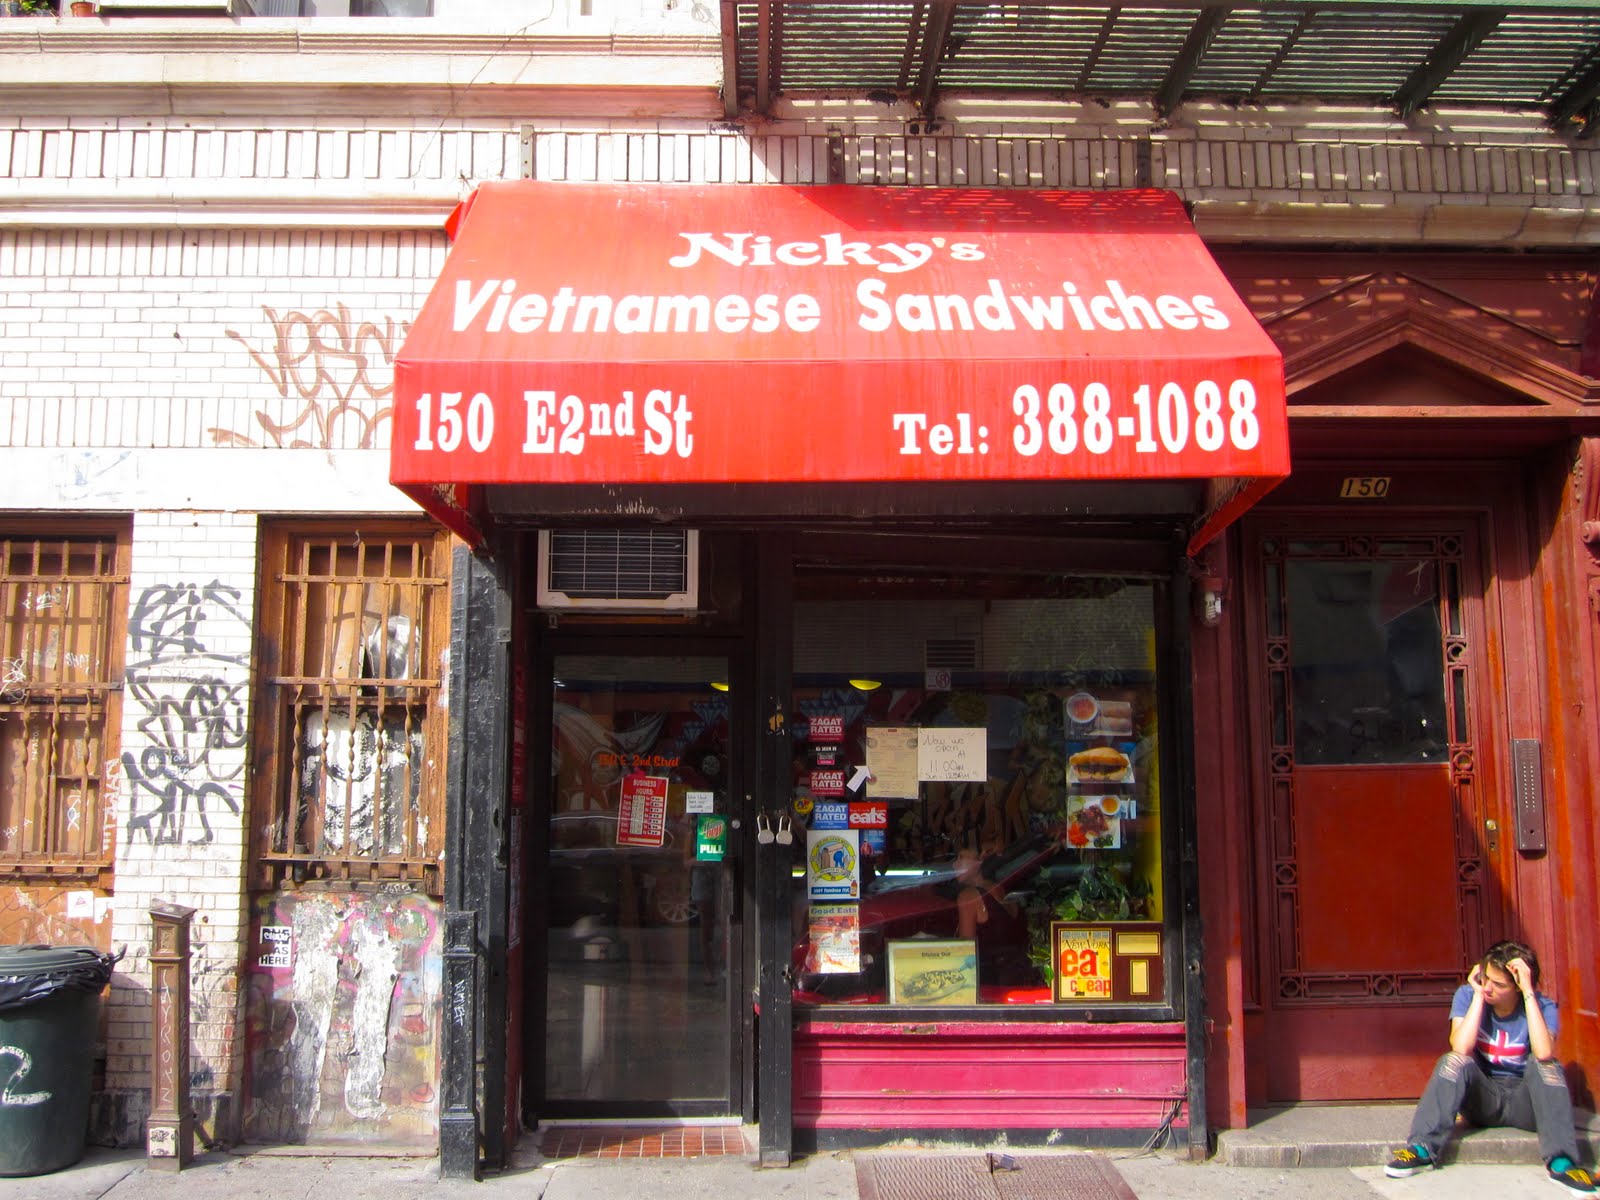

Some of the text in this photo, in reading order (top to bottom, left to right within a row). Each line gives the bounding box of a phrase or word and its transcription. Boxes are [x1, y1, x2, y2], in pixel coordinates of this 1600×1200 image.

[668, 232, 986, 274] Nicky's
[452, 277, 1231, 335] Vietnamese Sandwiches
[414, 391, 494, 453] 150
[893, 379, 1260, 456] Tel: 388-1088
[1345, 478, 1388, 496] 150
[810, 718, 842, 726] ZAGAT
[810, 726, 842, 734] RATED
[811, 772, 843, 780] ZAGAT
[633, 779, 657, 787] BUSINESS
[811, 780, 843, 788] RATED
[815, 805, 847, 813] ZAGAT
[815, 812, 847, 821] RATED
[849, 807, 887, 824] eats
[700, 844, 724, 854] PULL
[811, 906, 857, 915] Good Eats
[260, 956, 289, 965] HERE
